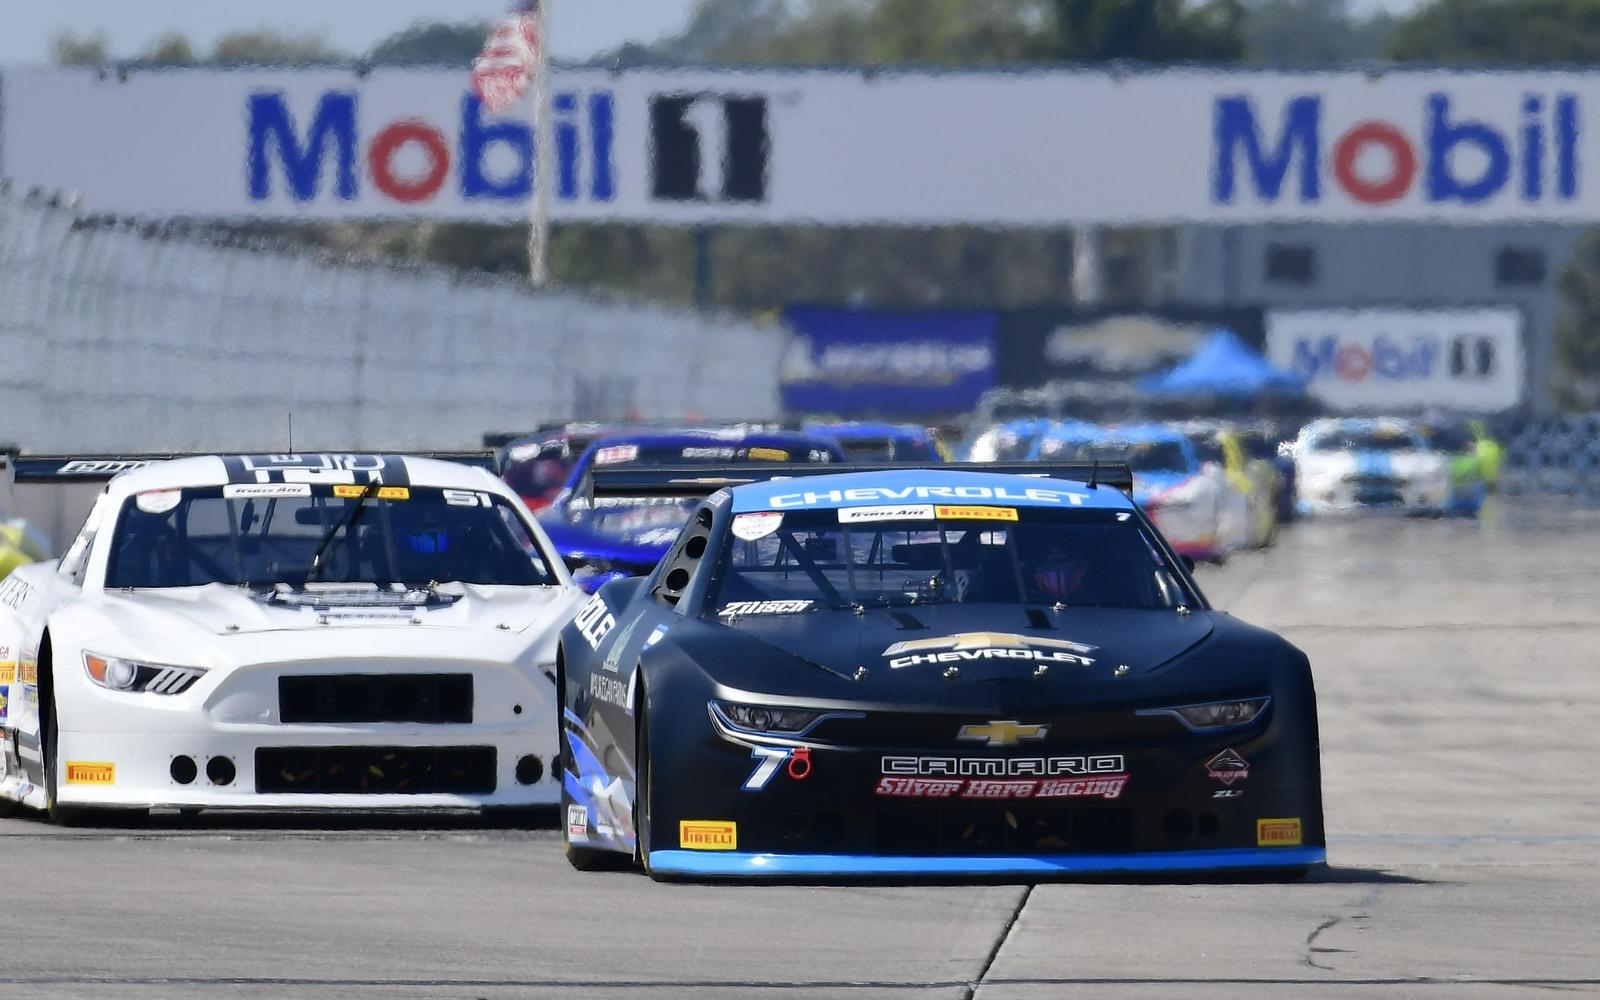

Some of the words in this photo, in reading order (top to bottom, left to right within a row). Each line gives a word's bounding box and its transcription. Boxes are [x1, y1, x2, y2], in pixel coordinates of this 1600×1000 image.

[246, 90, 617, 203] Mobil
[677, 95, 733, 201] 1
[1211, 92, 1582, 206] Mobil
[1293, 332, 1441, 384] Mobil
[443, 489, 493, 508] 51
[769, 486, 1090, 508] CHEVROLET
[940, 508, 1012, 518] PIRELLI
[1115, 512, 1132, 522] 7
[718, 600, 815, 616] Zilisch
[889, 649, 1097, 669] CHEVROLET
[67, 764, 114, 782] PIRELLI
[741, 746, 793, 791] 7
[881, 754, 1125, 776] CAMARO
[876, 776, 963, 798] Silver
[962, 779, 1037, 798] Hare
[1035, 774, 1130, 799] Racing
[683, 825, 733, 845] PIRELLI
[1260, 823, 1299, 841] PIRELLI
